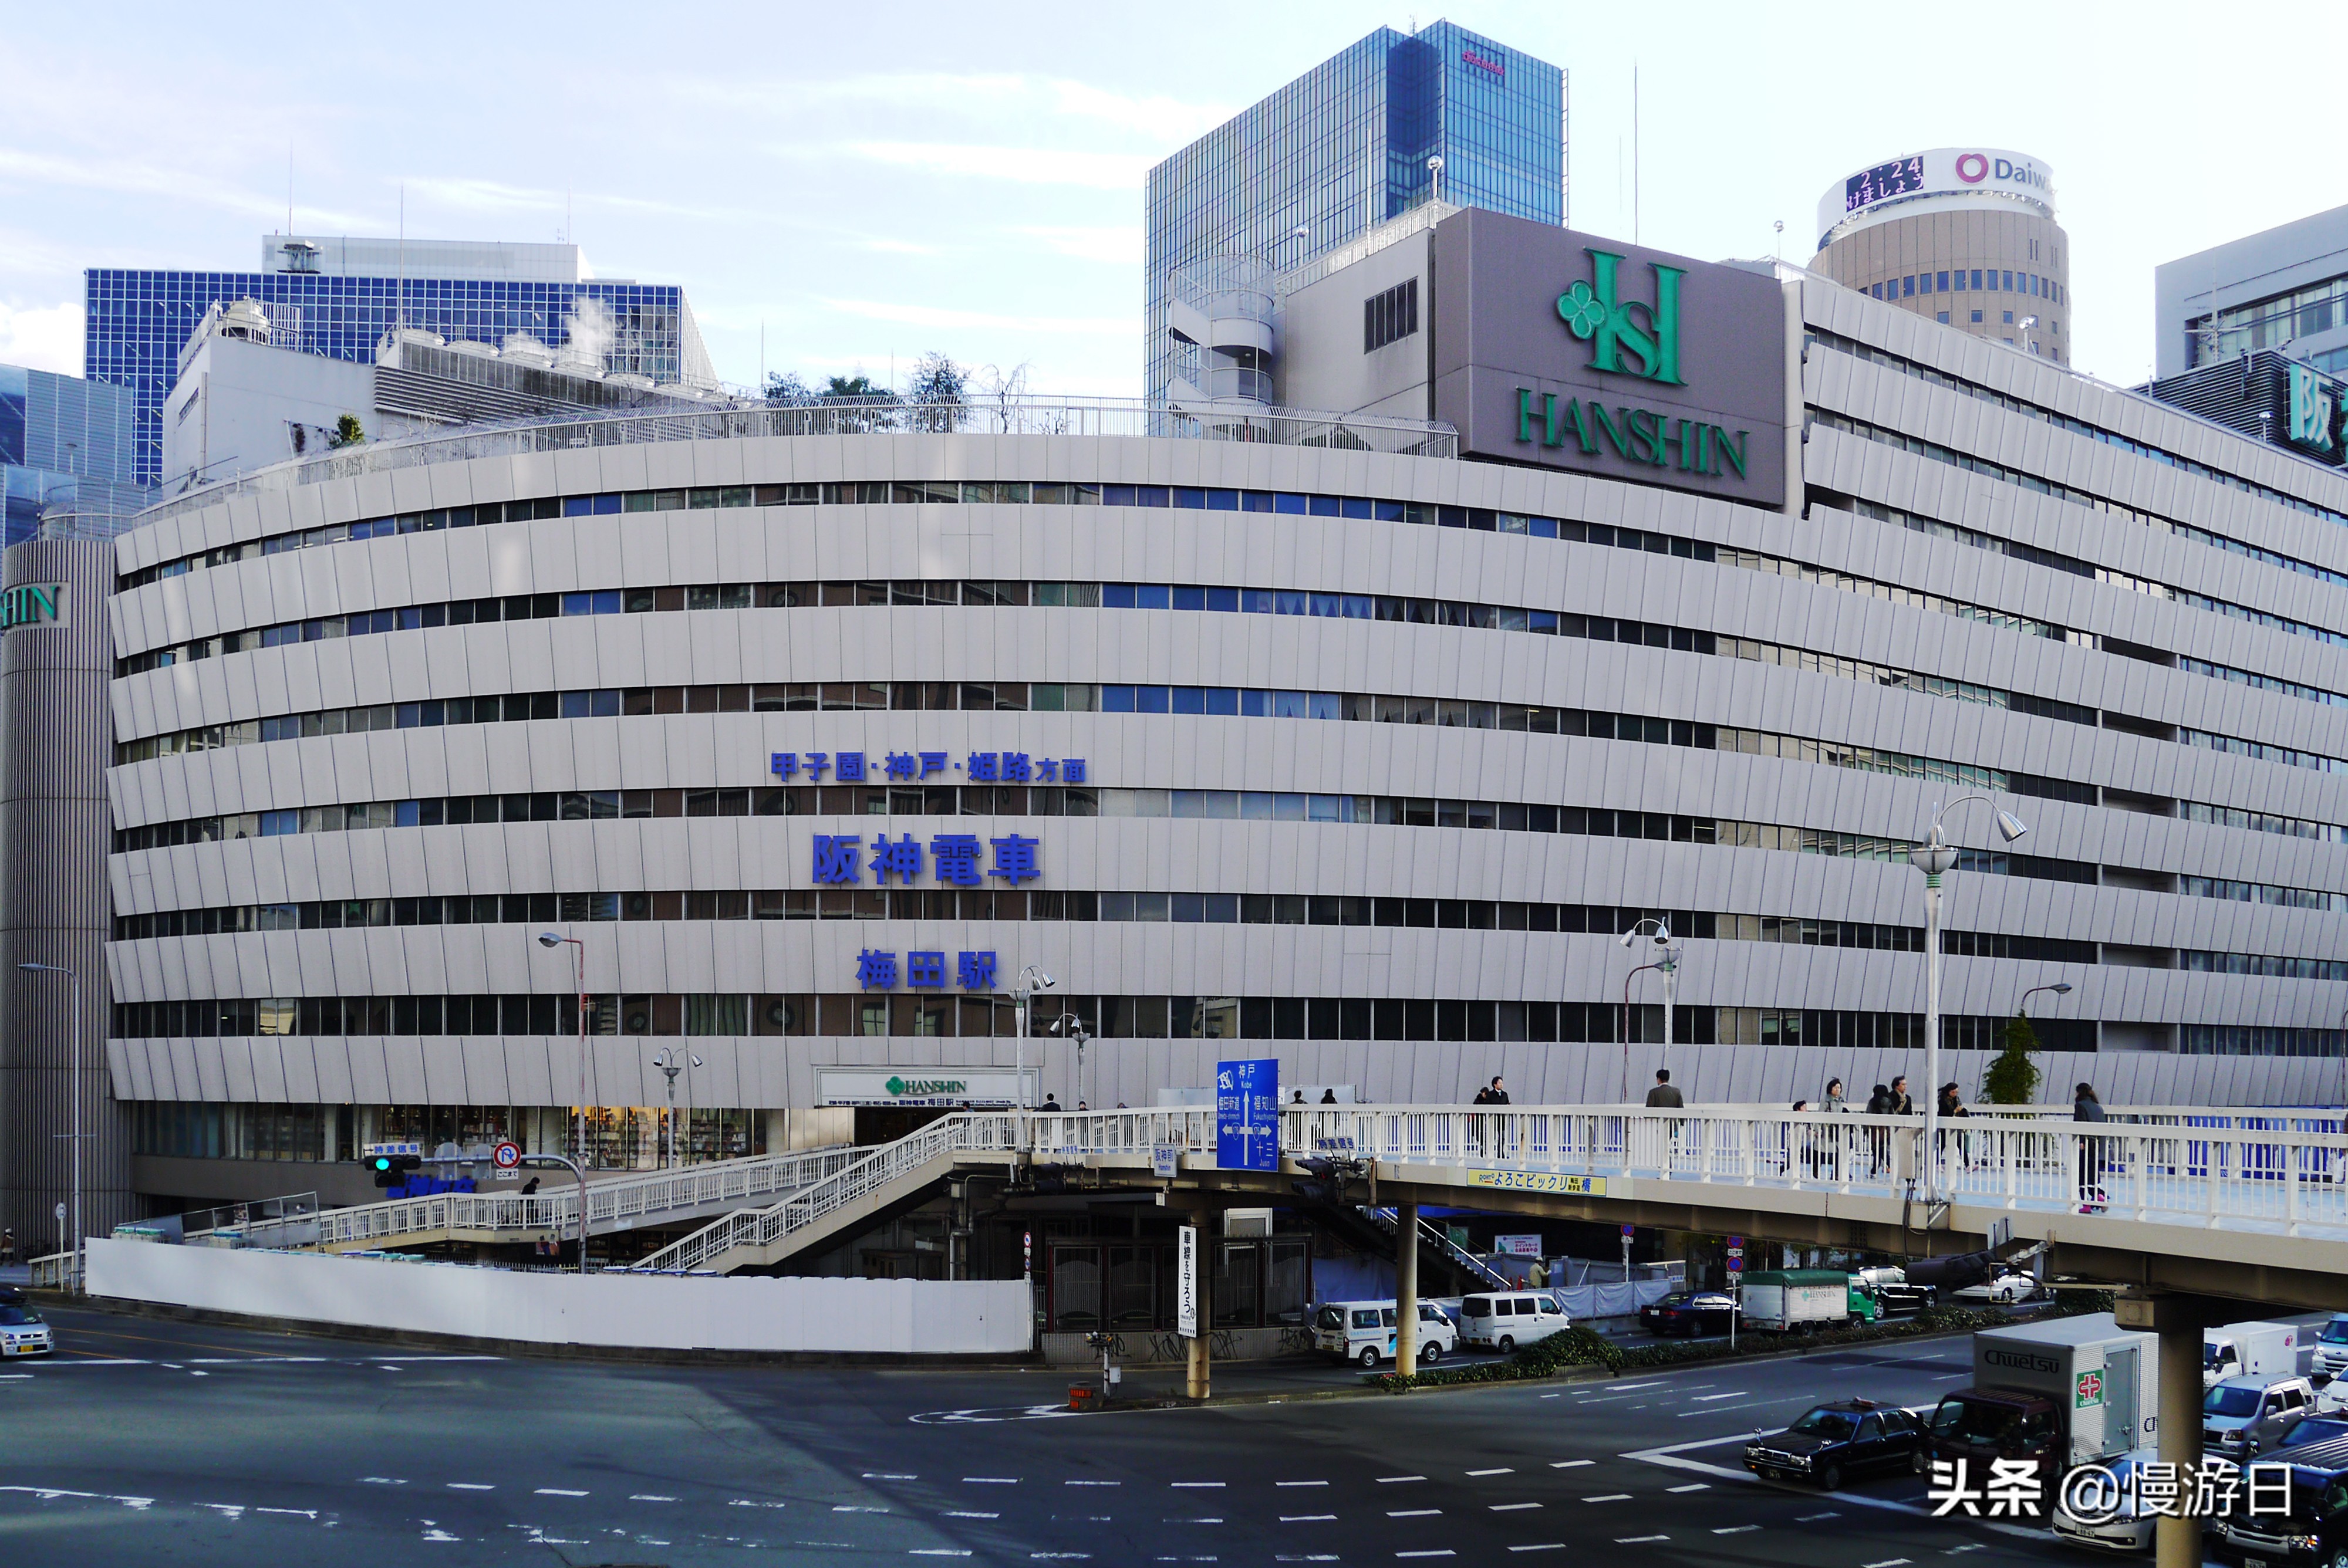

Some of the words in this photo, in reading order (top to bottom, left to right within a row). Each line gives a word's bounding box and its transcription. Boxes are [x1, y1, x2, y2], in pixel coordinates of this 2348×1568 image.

[1861, 157, 1921, 188] 2:24
[1516, 386, 1750, 480] HANSHIN
[0, 586, 60, 629] HIN
[812, 833, 1041, 886] 阪神電車
[856, 948, 997, 990] 梅田駅
[1239, 1064, 1255, 1079] 神戸
[905, 1080, 967, 1093] HANSHIN
[928, 1098, 954, 1106] 梅田駅
[1254, 1095, 1277, 1110] 福知山
[375, 1144, 417, 1154] 時差信号
[1155, 1148, 1173, 1162] 阪神前
[1256, 1141, 1273, 1157] 十三
[1479, 1174, 1495, 1182] ROHTO
[1984, 1349, 2060, 1374] Chuetsu
